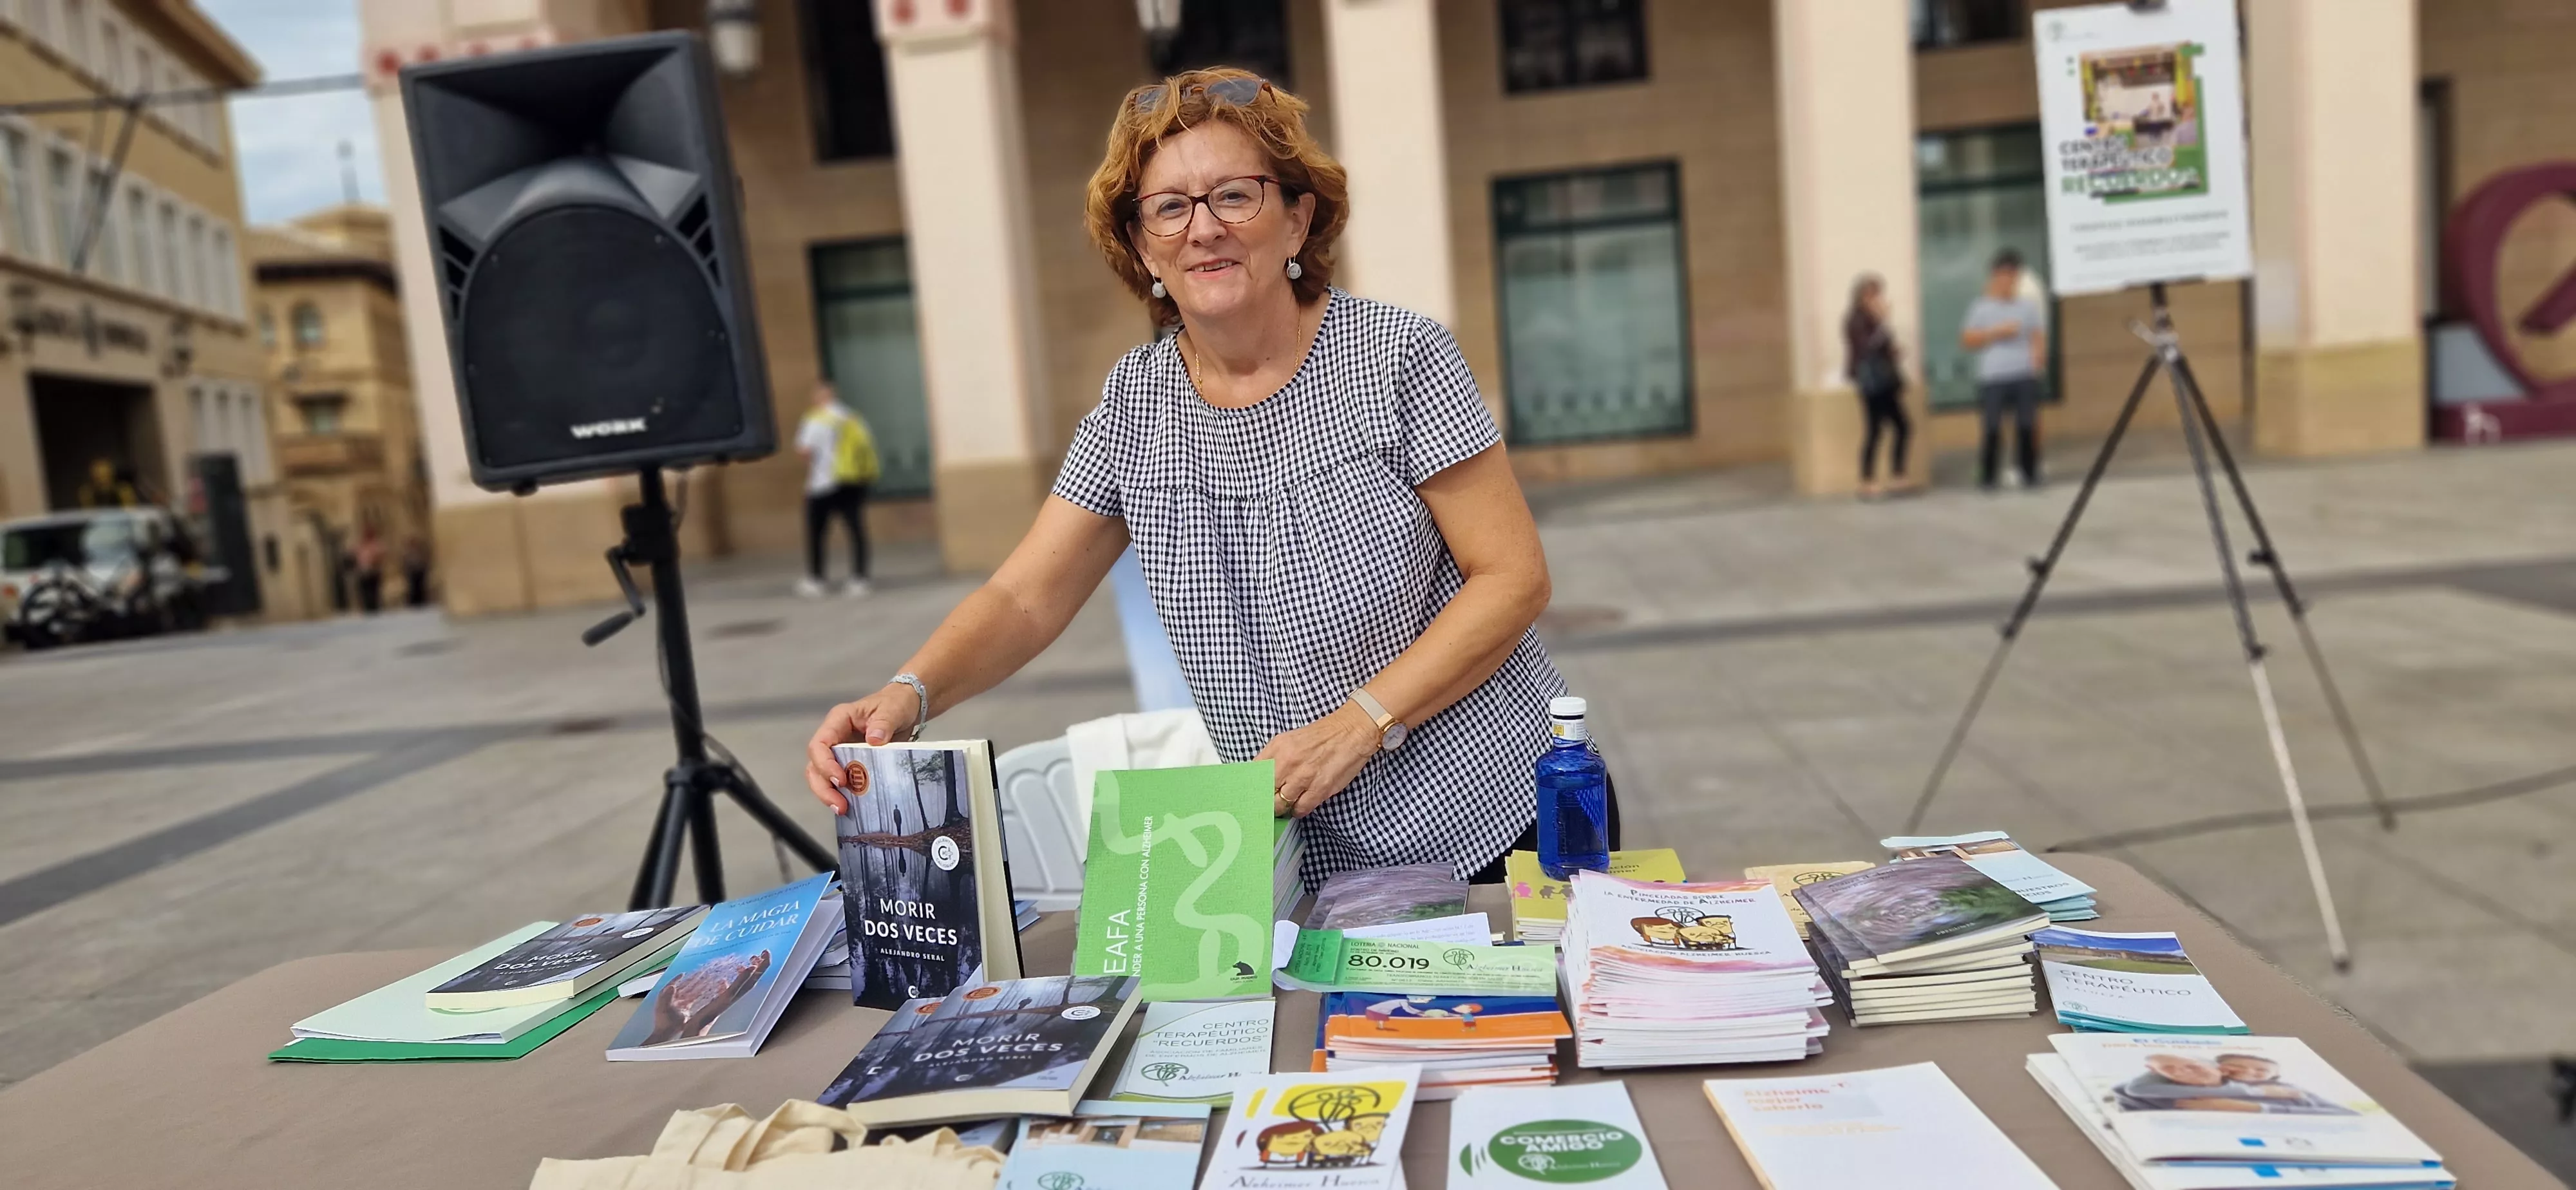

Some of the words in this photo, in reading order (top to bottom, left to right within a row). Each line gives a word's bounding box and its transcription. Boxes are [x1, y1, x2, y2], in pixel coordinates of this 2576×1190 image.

[1142, 816, 1153, 857] ALZHEIMER
[1140, 859, 1150, 880] CON
[1136, 882, 1148, 920] PERSONA
[1617, 894, 1680, 905] ENFERMEDAD
[710, 919, 734, 933] LA
[737, 900, 800, 927] MAGIA
[880, 898, 936, 919] MORIR
[694, 934, 723, 948] DE
[725, 913, 799, 942] CUIDAR
[864, 920, 899, 939] DOS
[902, 924, 958, 945] VECES
[1135, 923, 1144, 943] UNA
[493, 961, 538, 970] DOS
[540, 953, 601, 967] VECES
[527, 949, 593, 962] MORIR
[880, 948, 920, 959] ALEJANDRO
[922, 953, 945, 961] SERAL
[1348, 954, 1430, 970] 80.019
[2060, 970, 2134, 985] CENTRO
[1155, 1026, 1268, 1038] TERAPÉUTICO
[1203, 1019, 1269, 1030] CENTRO
[952, 1033, 1040, 1048] MORIR
[1153, 1035, 1268, 1046] "RECUERDOS"
[913, 1047, 970, 1062] DOS
[980, 1043, 1063, 1054] VECES
[1500, 1131, 1624, 1145] COMERCIO
[1525, 1142, 1604, 1153] AMIGO
